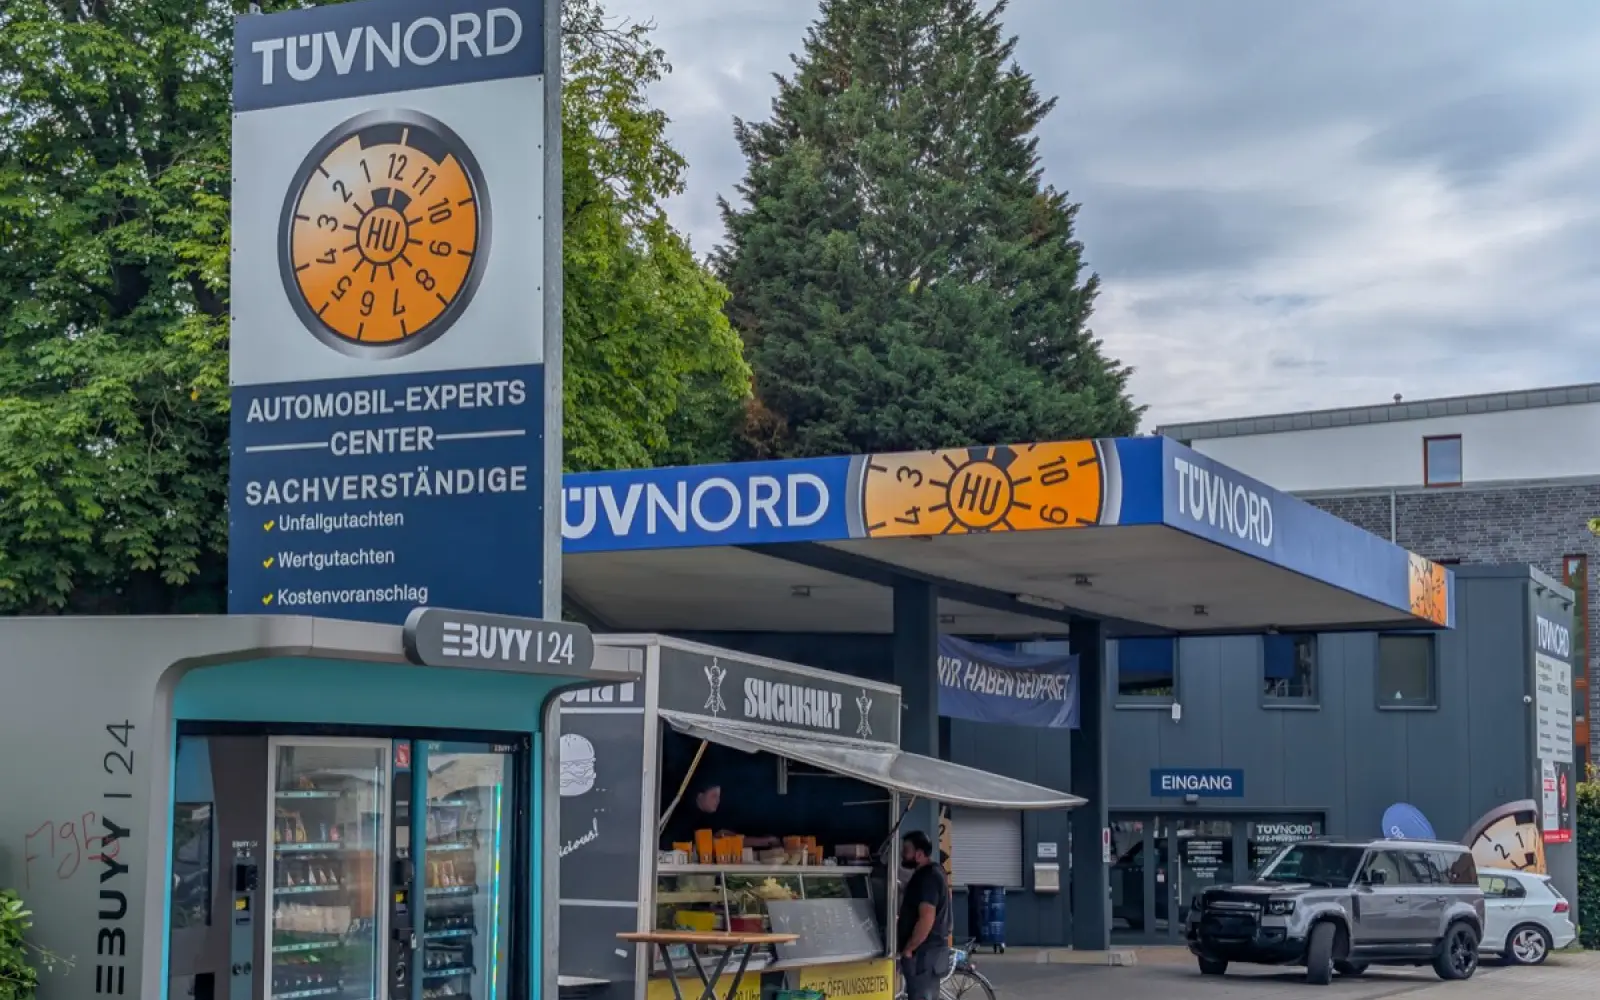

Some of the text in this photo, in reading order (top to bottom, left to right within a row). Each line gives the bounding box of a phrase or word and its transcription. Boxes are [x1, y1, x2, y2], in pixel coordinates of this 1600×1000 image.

[360, 159, 371, 183] 1
[388, 153, 408, 182] 12
[332, 179, 353, 203] 2
[412, 166, 437, 196] 11
[317, 214, 338, 232] 3
[427, 198, 453, 225] 10
[366, 217, 400, 252] HU
[316, 248, 337, 265] 4
[429, 241, 452, 257] 9
[331, 275, 353, 301] 5
[415, 269, 436, 292] 8
[360, 291, 375, 316] 6
[392, 288, 406, 316] 7
[246, 379, 526, 423] AUTOMOBIL-EXPERTS
[330, 426, 434, 456] CENTER
[896, 466, 923, 488] 3
[1038, 455, 1069, 487] 10
[246, 465, 527, 506] SACHVERSTÄNDIGE
[958, 472, 1002, 516] HU
[561, 473, 830, 539] ÜVNORD
[894, 505, 920, 526] 4
[1040, 504, 1068, 525] 9
[279, 511, 404, 534] Unfallgutachten
[278, 548, 395, 571] Wertgutachten
[278, 584, 428, 607] Kostenvoranschlag
[442, 622, 532, 662] EBUYY
[547, 631, 575, 665] 24
[964, 661, 1014, 698] HABEN
[744, 677, 842, 730] SUCUKULT
[104, 719, 135, 775] 24
[1162, 775, 1233, 790] EINGANG
[1494, 843, 1510, 860] 2
[1515, 831, 1524, 848] 1
[95, 816, 131, 995] EBUYY
